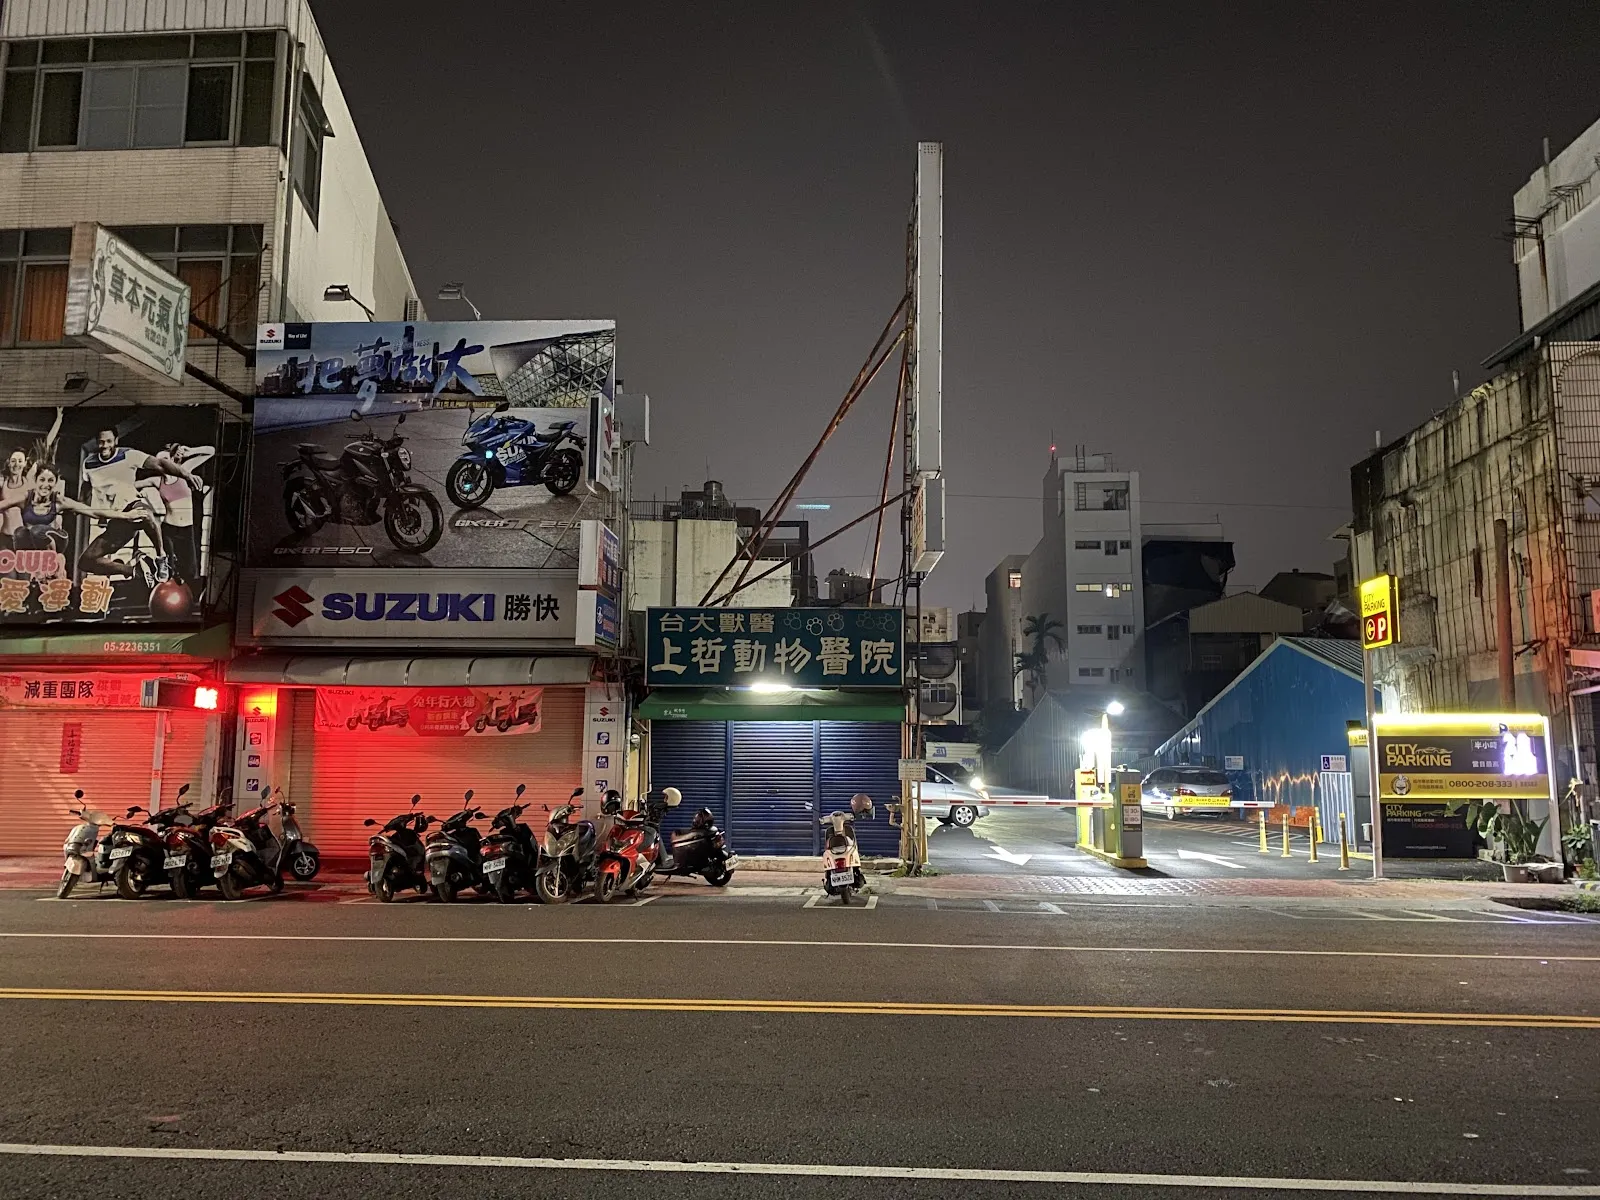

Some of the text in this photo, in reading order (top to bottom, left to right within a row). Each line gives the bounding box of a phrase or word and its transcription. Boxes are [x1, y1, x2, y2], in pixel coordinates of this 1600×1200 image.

[108, 264, 173, 335] 草本元氣
[0, 578, 114, 613] 愛運動
[322, 593, 495, 621] SUZUKI
[503, 594, 560, 622] 勝快
[659, 612, 775, 633] 台大獸醫
[1377, 617, 1387, 640] P
[103, 642, 161, 652] 05-2236351
[651, 637, 898, 675] 上哲動物醫院
[24, 680, 95, 699] 減重團隊
[1385, 744, 1418, 755] CITY
[1386, 755, 1452, 767] PARKING
[1449, 780, 1512, 788] 0800-208-333
